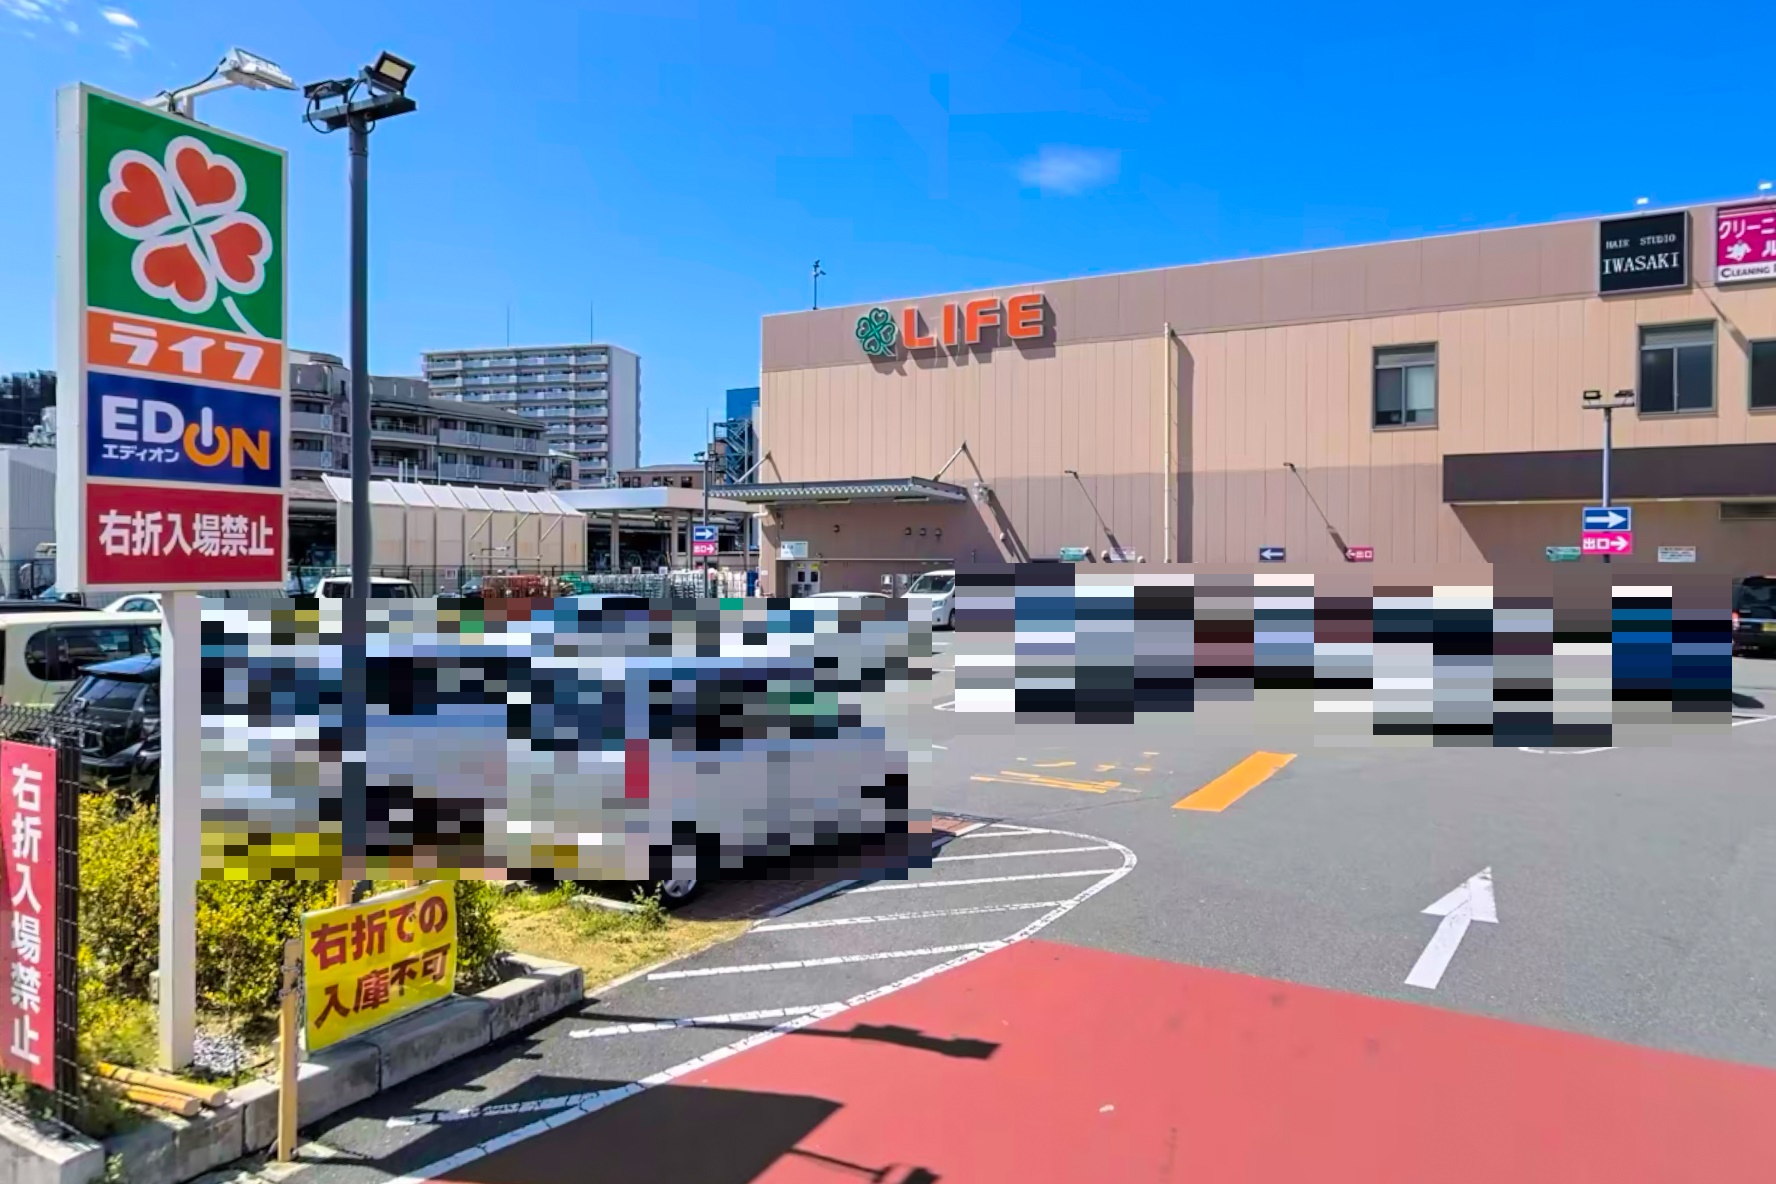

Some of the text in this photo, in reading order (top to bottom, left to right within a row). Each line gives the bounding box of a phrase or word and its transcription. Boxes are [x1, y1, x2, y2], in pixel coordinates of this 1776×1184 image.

[1602, 251, 1680, 275] IWASAKI
[1606, 233, 1677, 250] HAIR STUDIO
[903, 291, 1044, 349] LIFE
[110, 321, 264, 381] ライフ
[102, 395, 270, 470] EDION
[102, 444, 180, 463] エディオン
[99, 509, 275, 557] 右折入場禁止
[1583, 537, 1610, 550] 出口
[10, 762, 43, 1066] 右折入場禁止
[311, 896, 448, 971] 右折での
[314, 943, 451, 1029] 入庫不可
